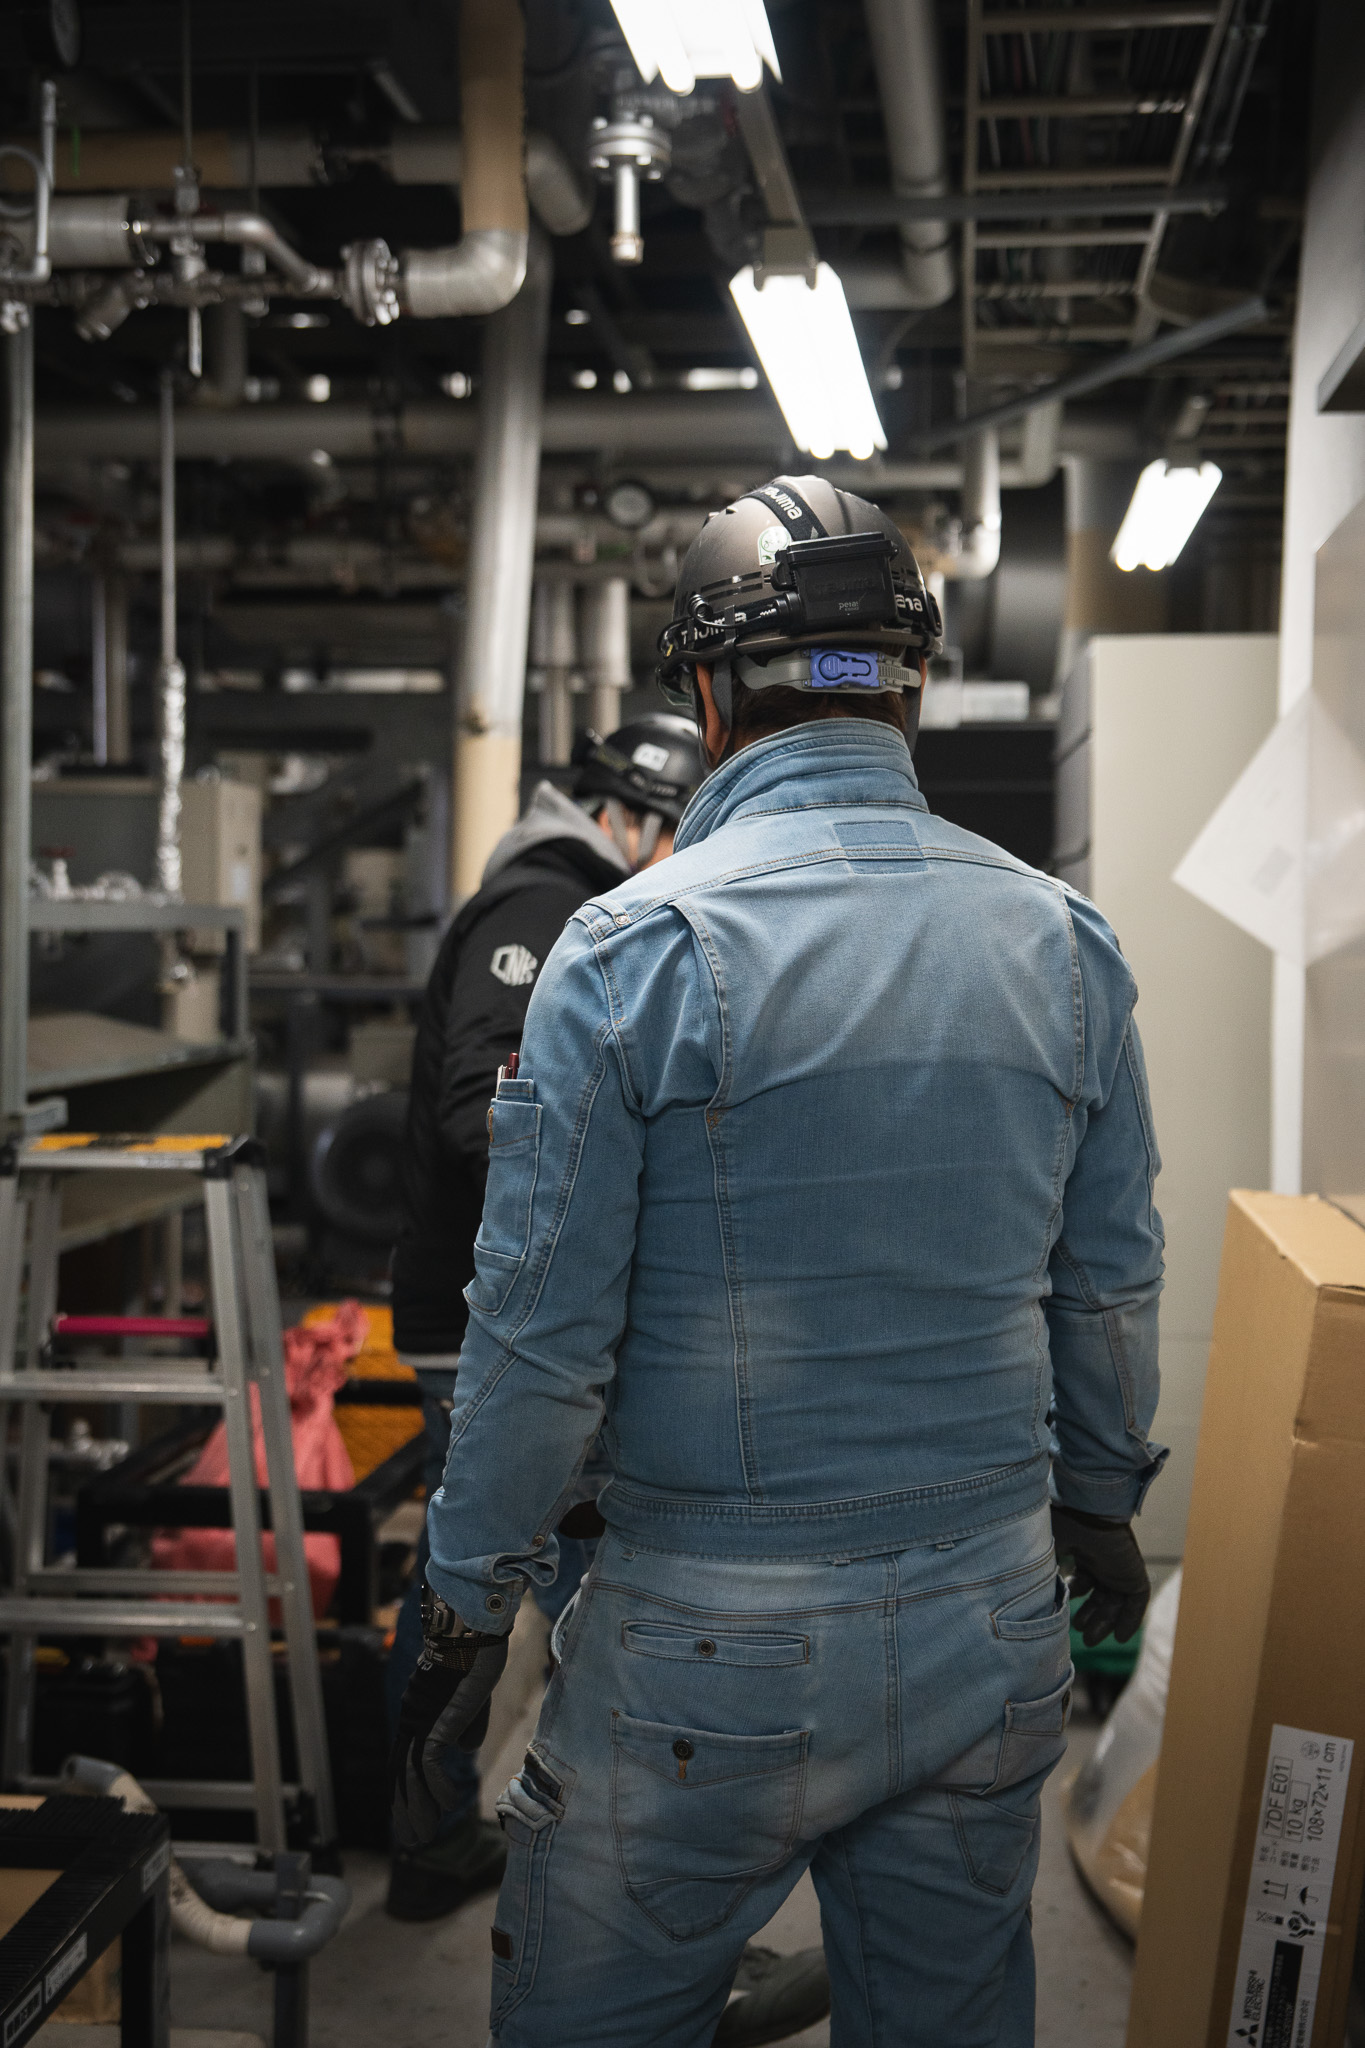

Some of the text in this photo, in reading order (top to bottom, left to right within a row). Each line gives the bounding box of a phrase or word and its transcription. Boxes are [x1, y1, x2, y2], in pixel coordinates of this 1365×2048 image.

[1323, 1742, 1337, 1763] cm
[1265, 1765, 1290, 1831] 7DF E01
[1287, 1798, 1308, 1837] 10 kg
